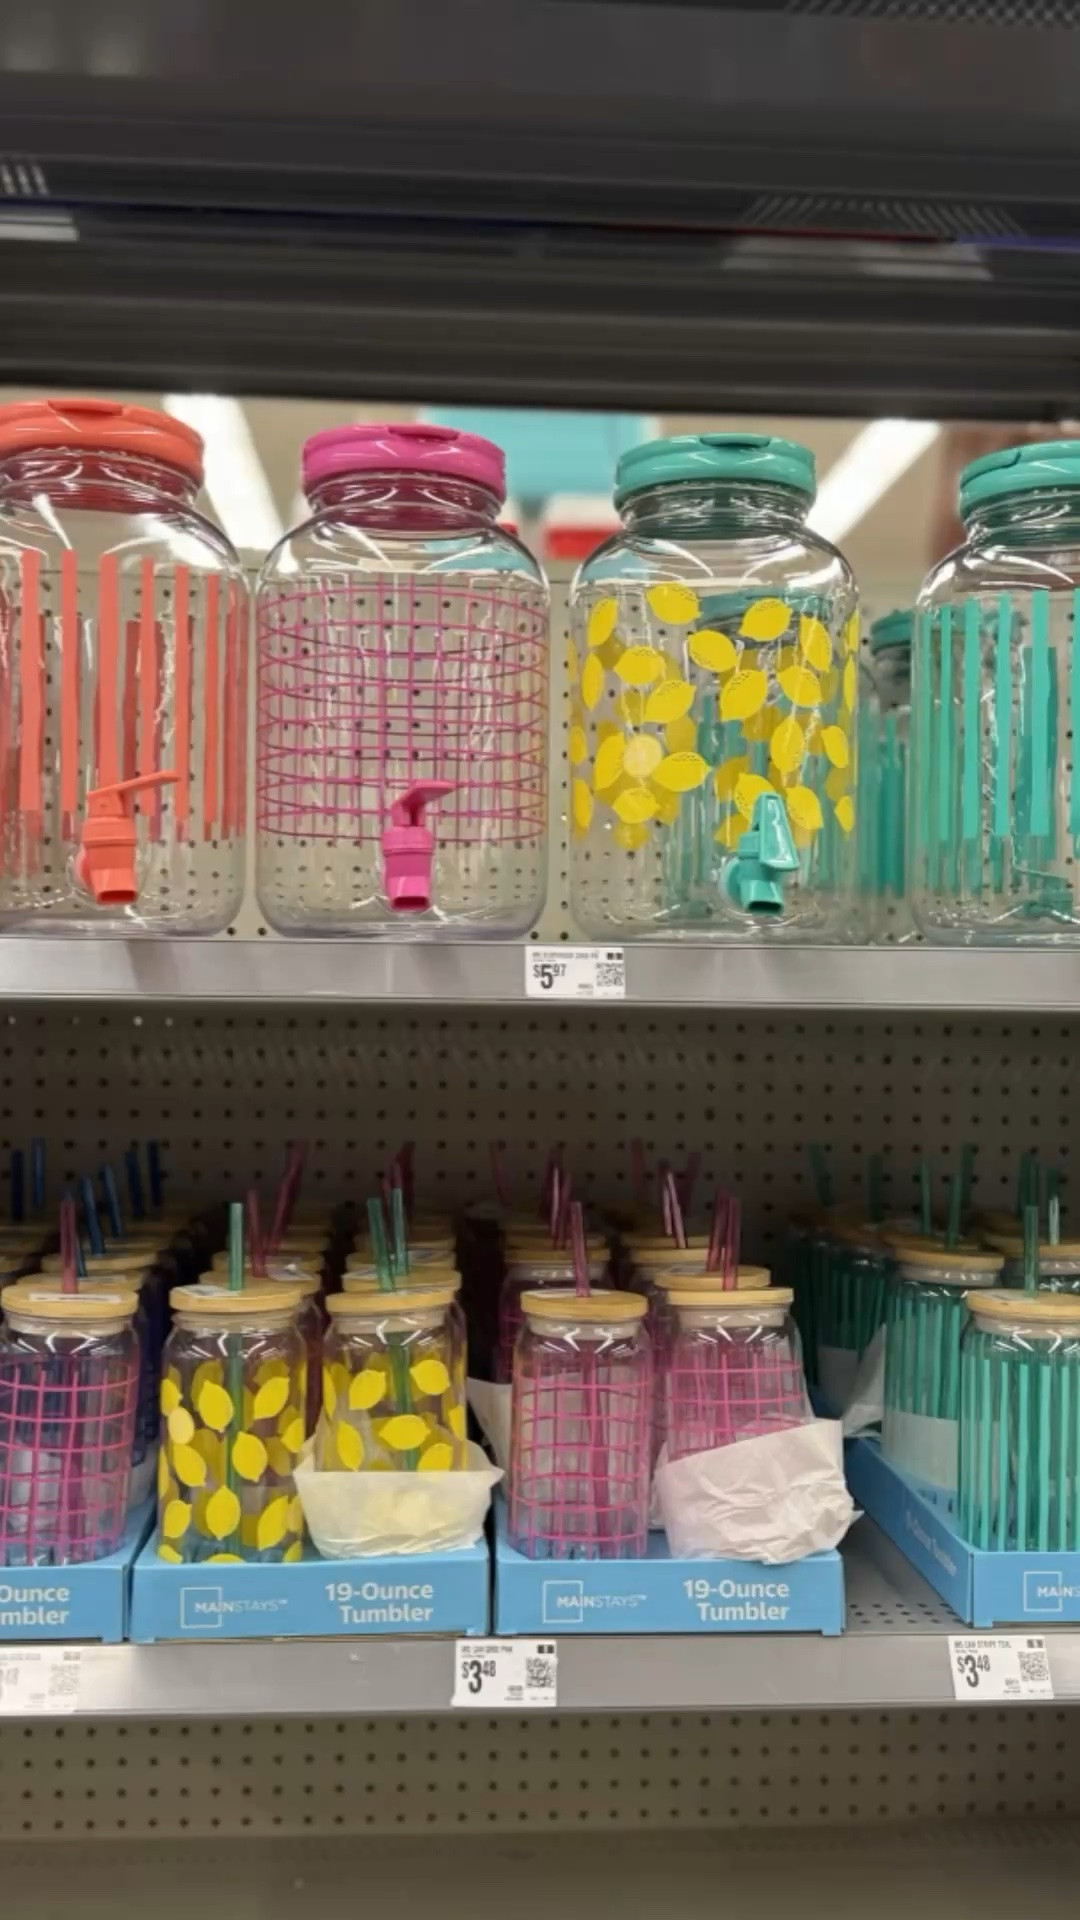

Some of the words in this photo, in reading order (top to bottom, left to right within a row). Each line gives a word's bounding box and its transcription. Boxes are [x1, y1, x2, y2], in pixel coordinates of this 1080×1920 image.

[325, 1582, 433, 1601] 19-Ounce
[683, 1579, 790, 1599] 19-Ounce
[340, 1604, 433, 1624] Tumbler
[697, 1601, 790, 1622] Tumbler
